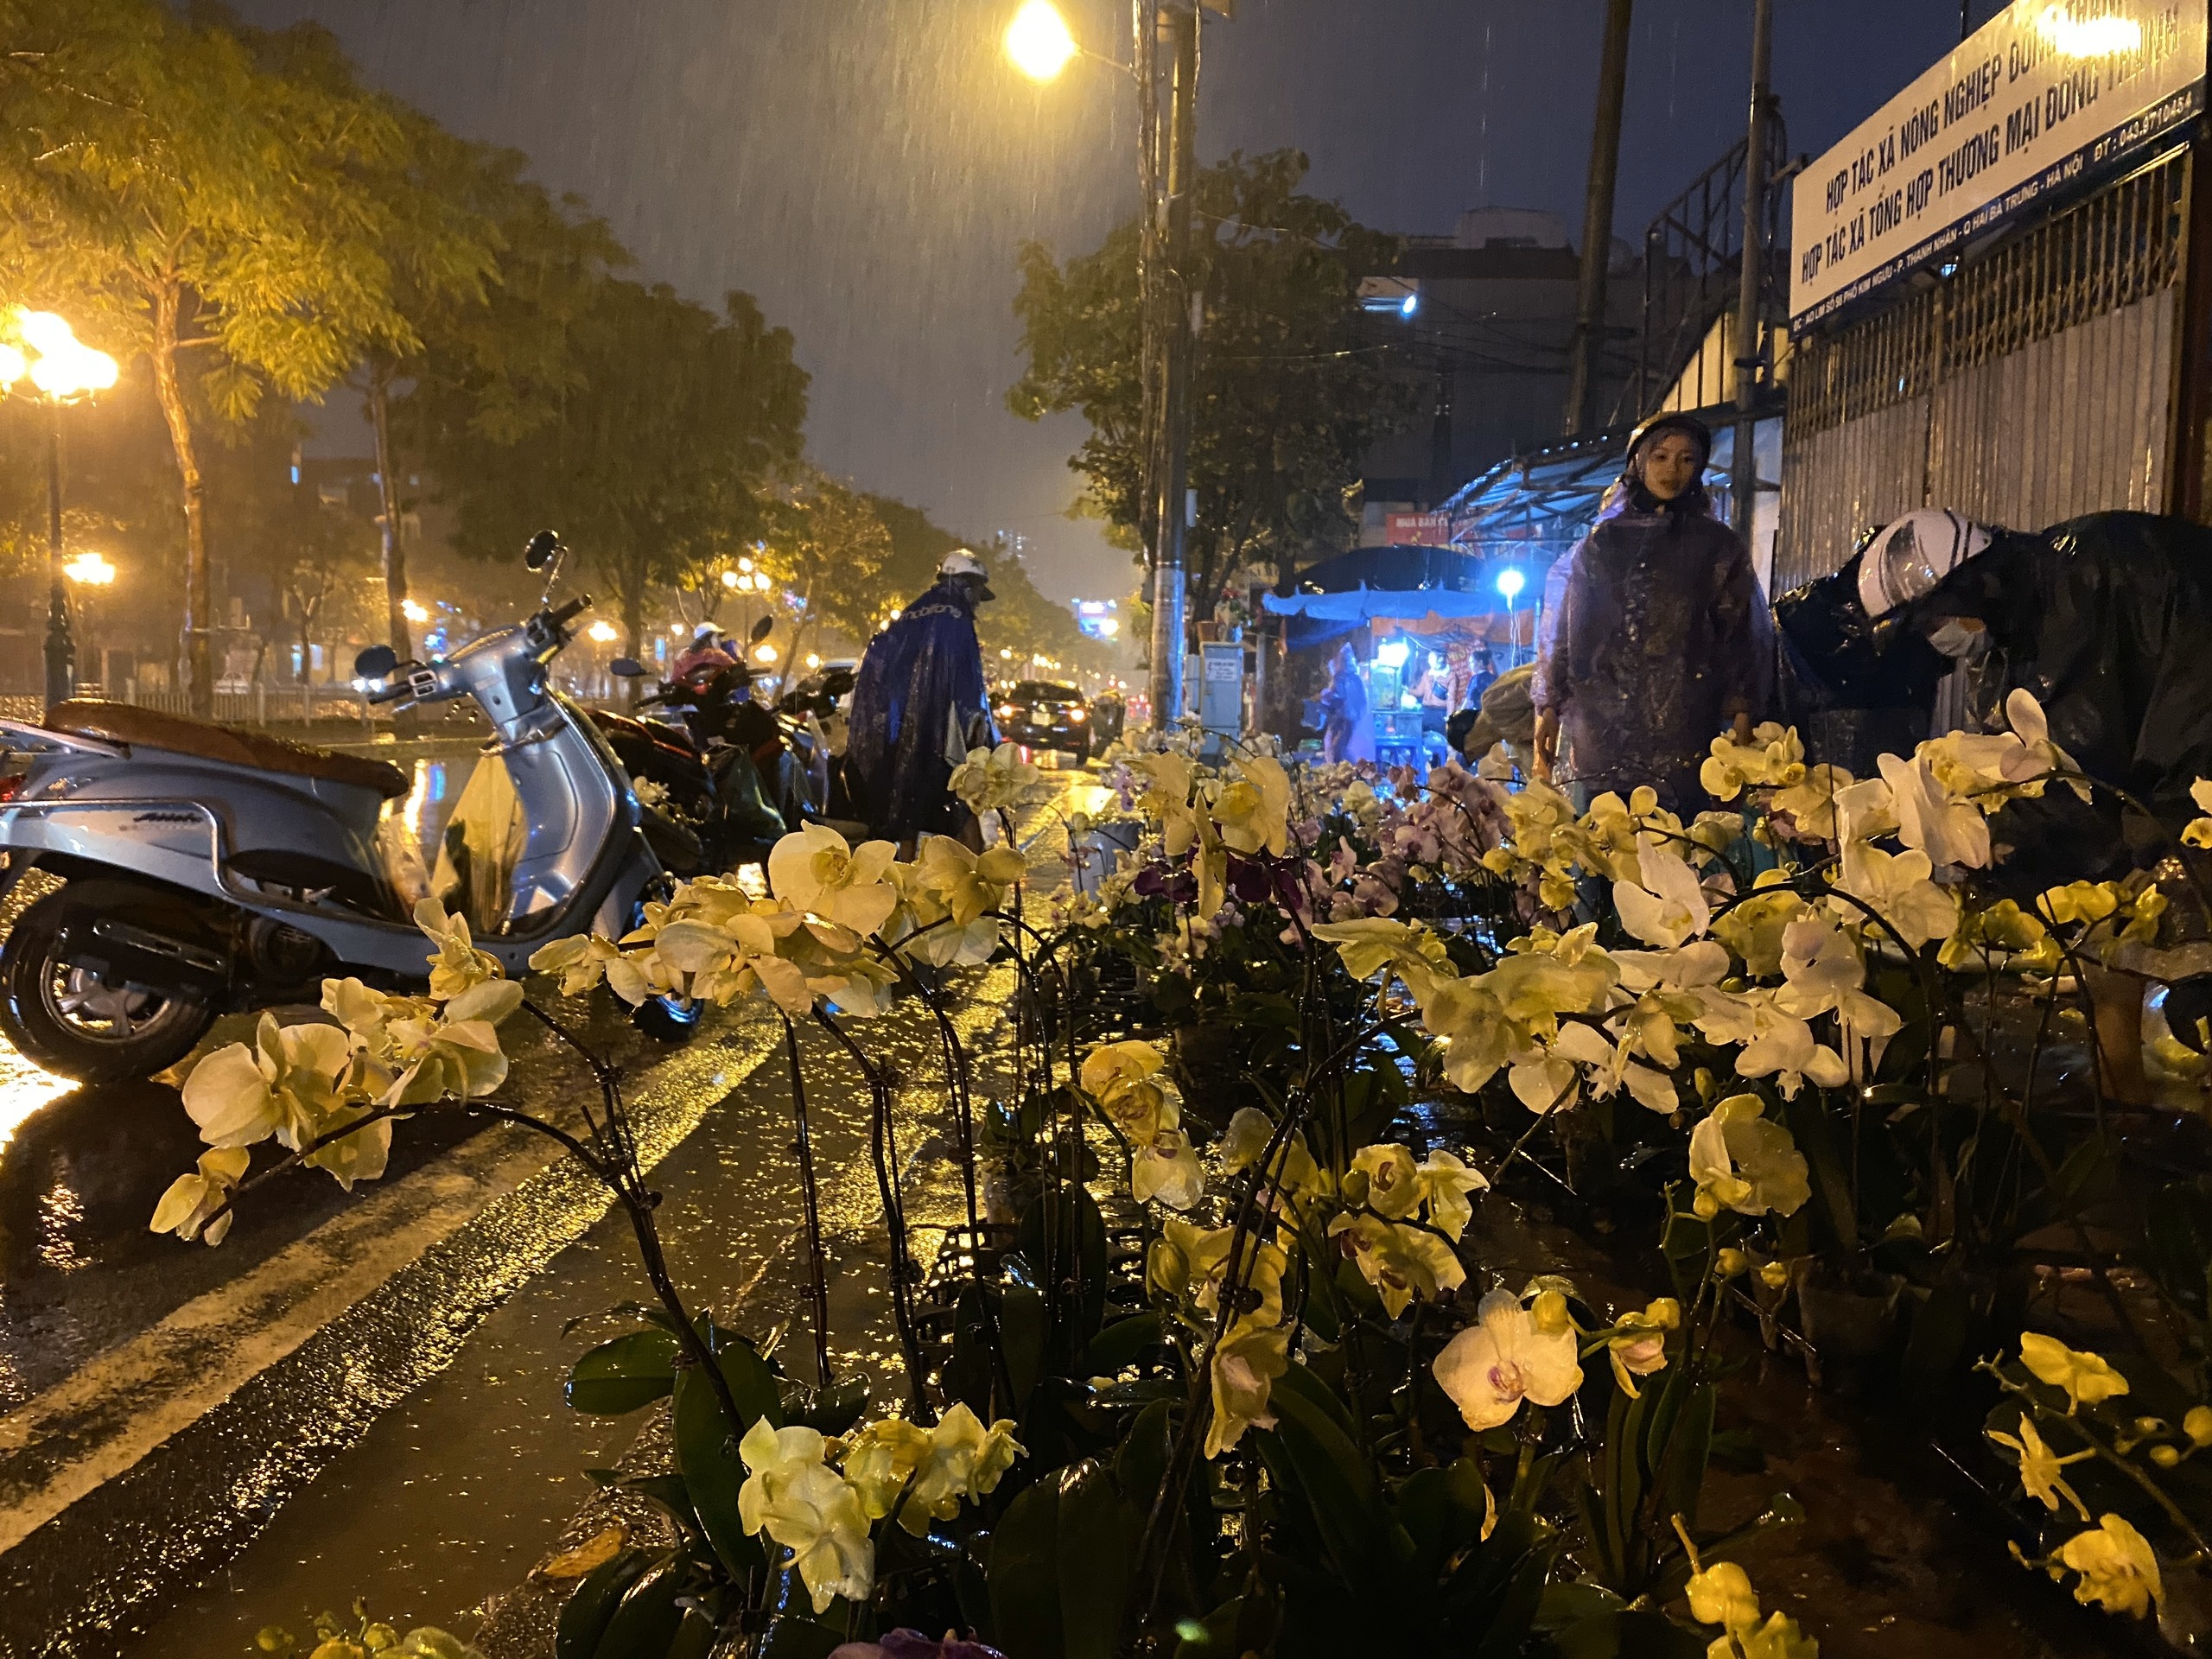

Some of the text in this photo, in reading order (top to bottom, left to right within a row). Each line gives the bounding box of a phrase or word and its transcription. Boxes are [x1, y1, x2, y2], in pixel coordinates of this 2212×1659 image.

[1801, 242, 1822, 286] HỢP
[1825, 223, 1847, 269] TÁC
[1849, 207, 1865, 255] XÃ
[1869, 184, 1903, 242] TỔNG
[1906, 168, 1934, 220] HỢP
[1938, 123, 1999, 198] THƯƠNG
[2006, 96, 2040, 158] MẠI
[1826, 169, 1848, 216] HỢP
[1852, 147, 1875, 195] TÁC
[1878, 124, 1896, 178] XÃ
[1900, 99, 1939, 162] NÔNG
[1944, 54, 2002, 127] NGHIỆP
[1906, 243, 1933, 267] THANH
[1973, 210, 1987, 232] HAI
[2005, 181, 2039, 212] TRƯNG
[2046, 164, 2062, 189] HÀ
[2063, 152, 2083, 177] NỘI
